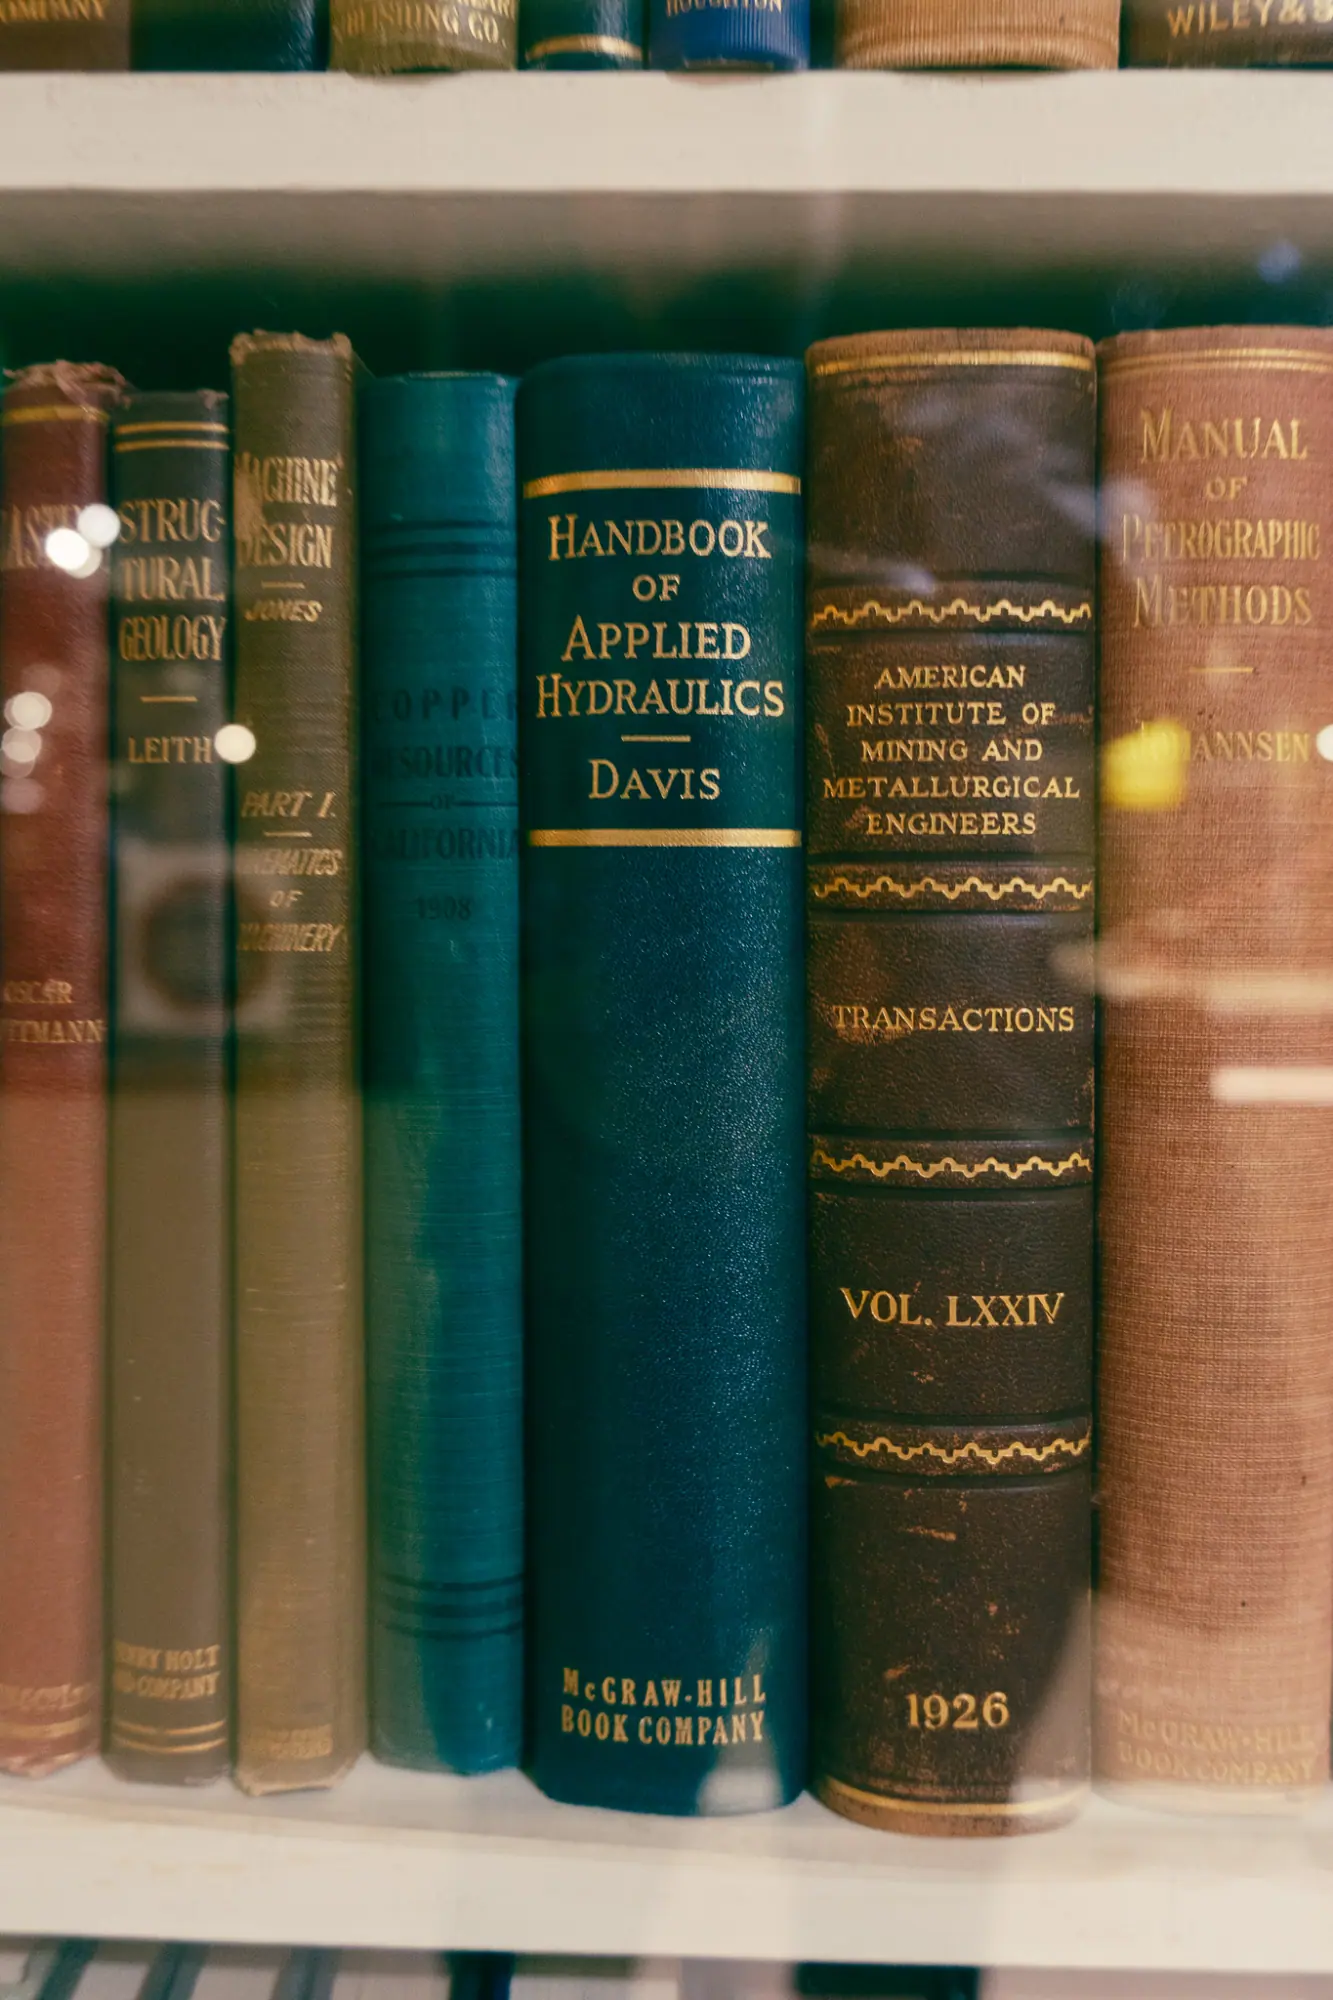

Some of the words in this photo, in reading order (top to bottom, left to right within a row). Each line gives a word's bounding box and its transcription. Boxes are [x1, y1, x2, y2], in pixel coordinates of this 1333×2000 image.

[1141, 407, 1308, 464] MANUAL
[1205, 476, 1248, 500] OF
[547, 513, 773, 561] HANDBOOK
[1122, 513, 1321, 563] PETROGRAPHIC
[120, 556, 226, 601] TURAL
[632, 574, 681, 602] OF
[245, 599, 324, 623] JONES
[1133, 573, 1313, 628] METHODS
[118, 614, 227, 661] GEOLOGY
[560, 614, 752, 662] APPLIED
[874, 664, 1027, 690] AMERICAN
[535, 672, 785, 718] HYDRAULICS
[846, 702, 1007, 727] INSTITUTE
[1021, 702, 1056, 726] OF
[128, 736, 213, 763] LEITH
[860, 739, 968, 763] MINING
[981, 738, 1043, 762] AND
[588, 759, 721, 800] DAVIS
[823, 776, 1080, 799] METALLURGICAL
[240, 791, 314, 818] PART
[865, 812, 1036, 836] ENGINEERS
[268, 889, 304, 909] OF
[833, 1005, 1075, 1033] TRANSACTIONS
[839, 1287, 935, 1327] VOL.
[946, 1291, 1065, 1328] LXXIV
[165, 1644, 221, 1671] HOLT
[561, 1704, 629, 1743] BOOK
[638, 1710, 765, 1746] COMPANY
[907, 1691, 1010, 1730] 1926
[1196, 1756, 1316, 1786] COMPANY
